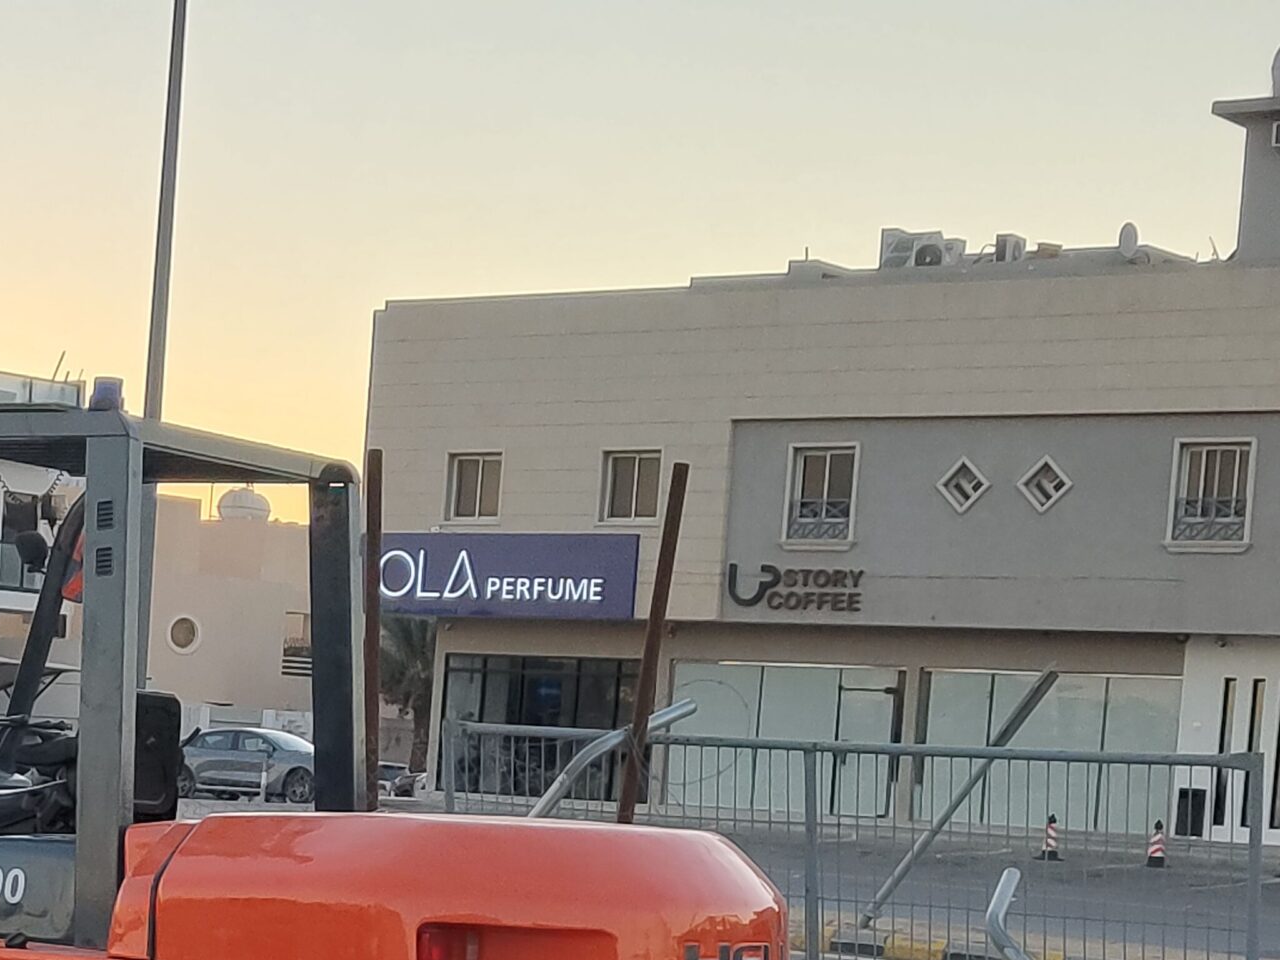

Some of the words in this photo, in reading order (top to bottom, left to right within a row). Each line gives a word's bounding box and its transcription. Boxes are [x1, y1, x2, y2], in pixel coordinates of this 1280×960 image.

[783, 569, 864, 588] STORY
[486, 577, 604, 601] PERFUME
[767, 591, 862, 611] COFFEE
